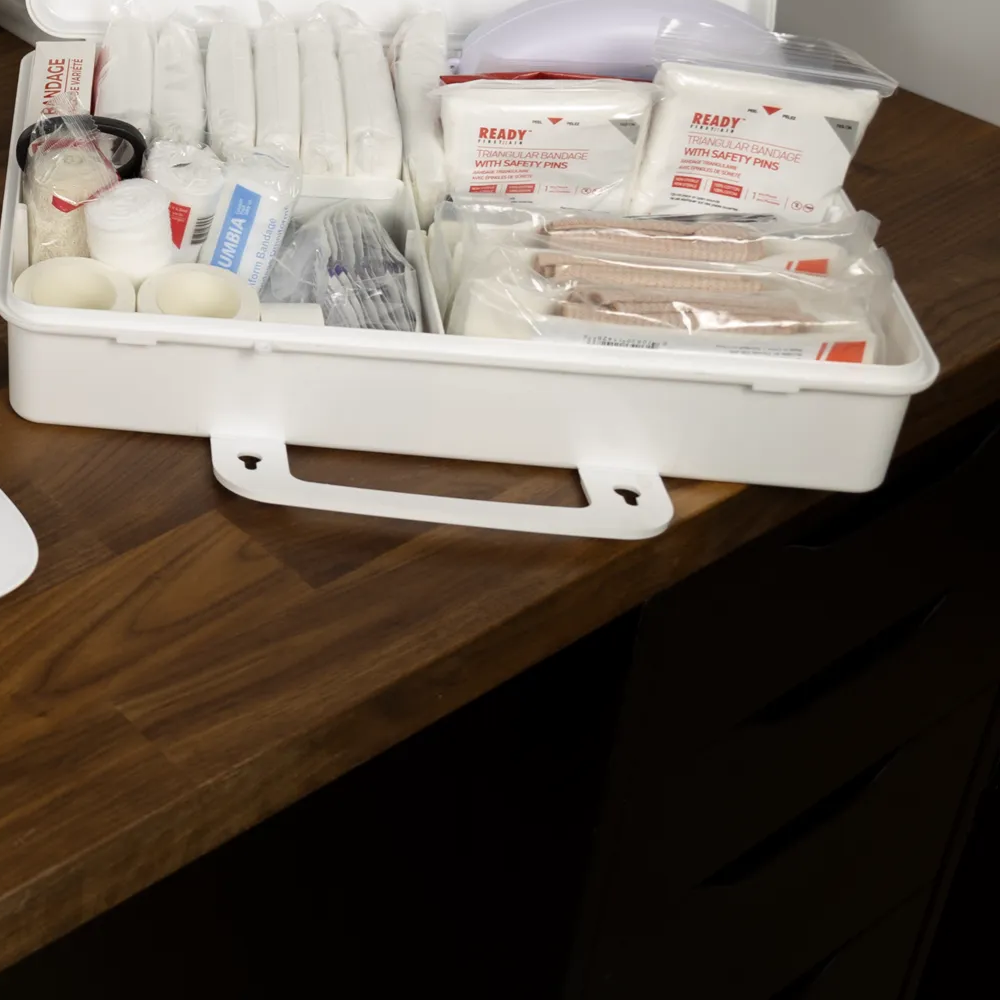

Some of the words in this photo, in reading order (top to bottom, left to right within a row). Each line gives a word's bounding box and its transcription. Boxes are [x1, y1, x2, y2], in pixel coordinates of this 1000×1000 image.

[70, 59, 83, 86] VARIÉTÉ
[692, 112, 741, 129] READY
[478, 127, 528, 141] READY
[476, 150, 539, 159] TRIANGULAR
[540, 152, 589, 161] BANDAGE
[684, 148, 710, 159] WITH
[712, 150, 751, 165] SAFETY
[753, 158, 780, 171] PINS
[688, 135, 751, 152] TRIANGULAR
[752, 144, 802, 164] BANDAGE
[475, 160, 502, 168] WITH
[504, 160, 542, 168] SAFETY
[544, 162, 568, 170] PINS
[218, 218, 247, 268] UMBIA
[256, 218, 277, 260] Bandage
